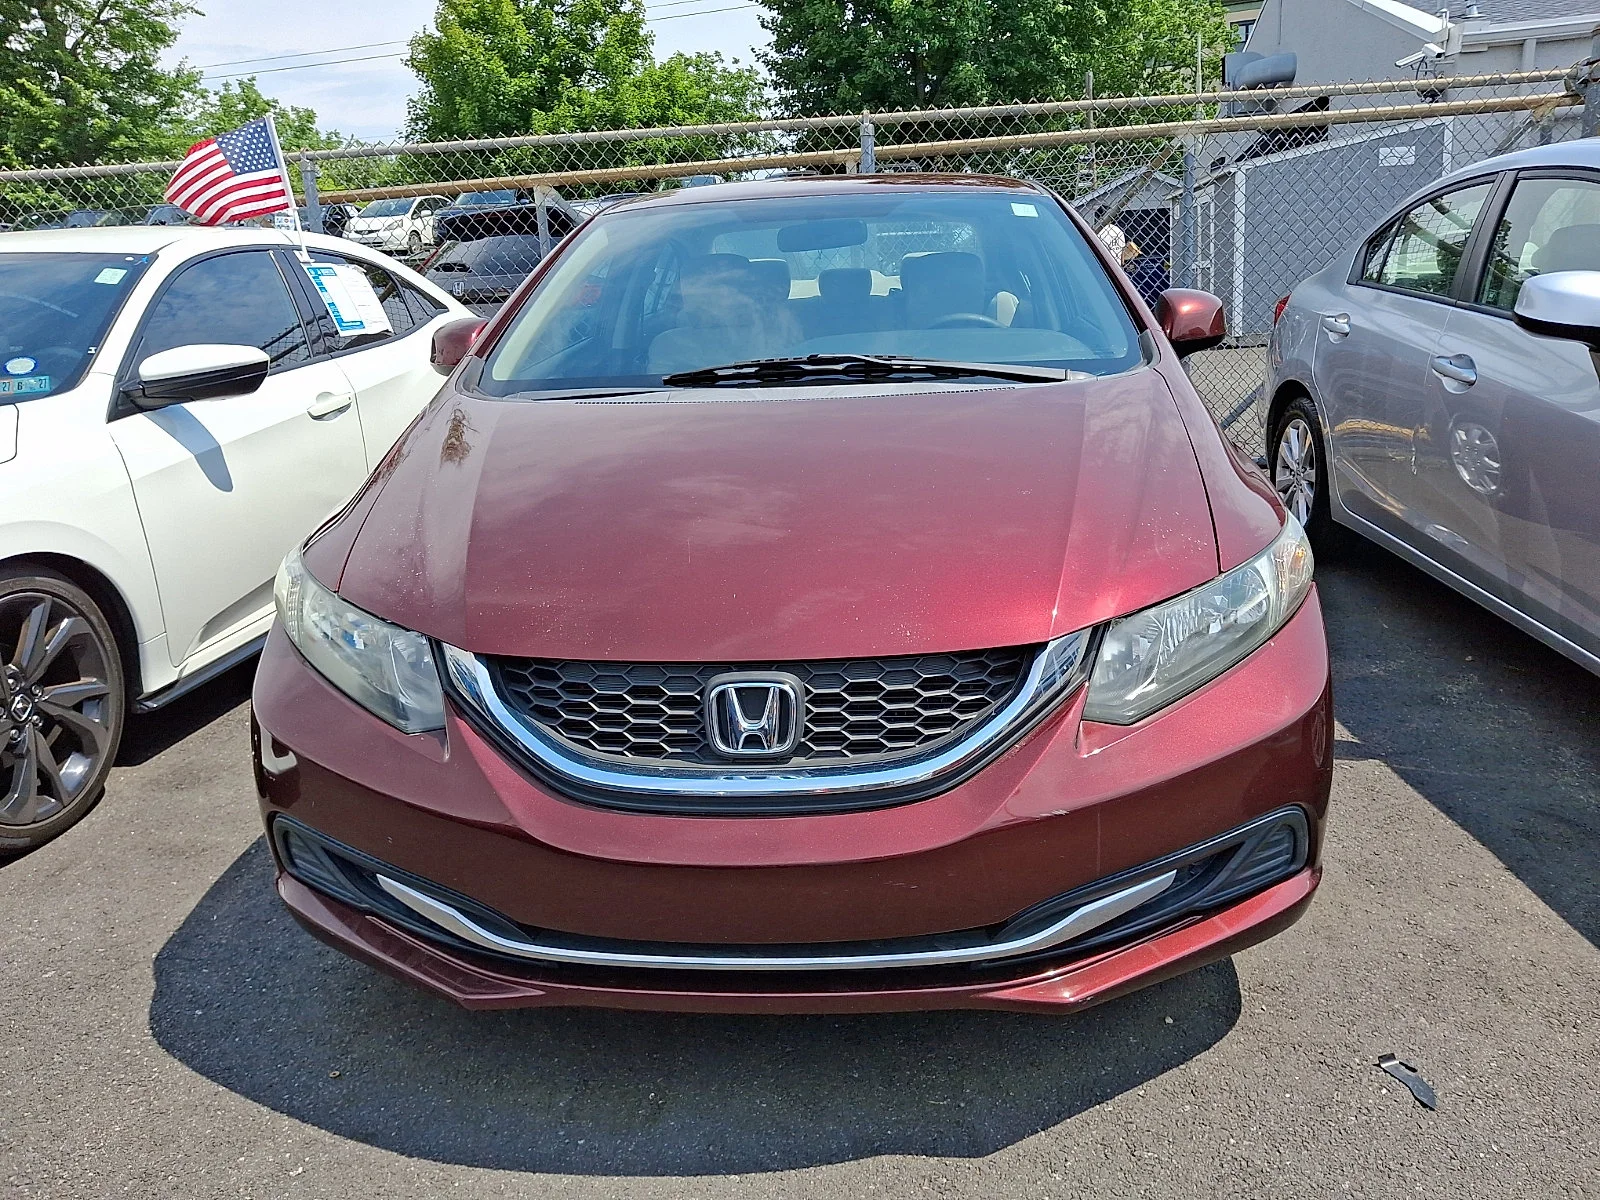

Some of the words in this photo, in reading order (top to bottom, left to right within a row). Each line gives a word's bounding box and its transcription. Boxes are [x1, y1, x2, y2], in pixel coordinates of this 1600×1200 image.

[2, 382, 10, 391] 27
[17, 382, 23, 390] 6
[38, 379, 47, 388] 27
